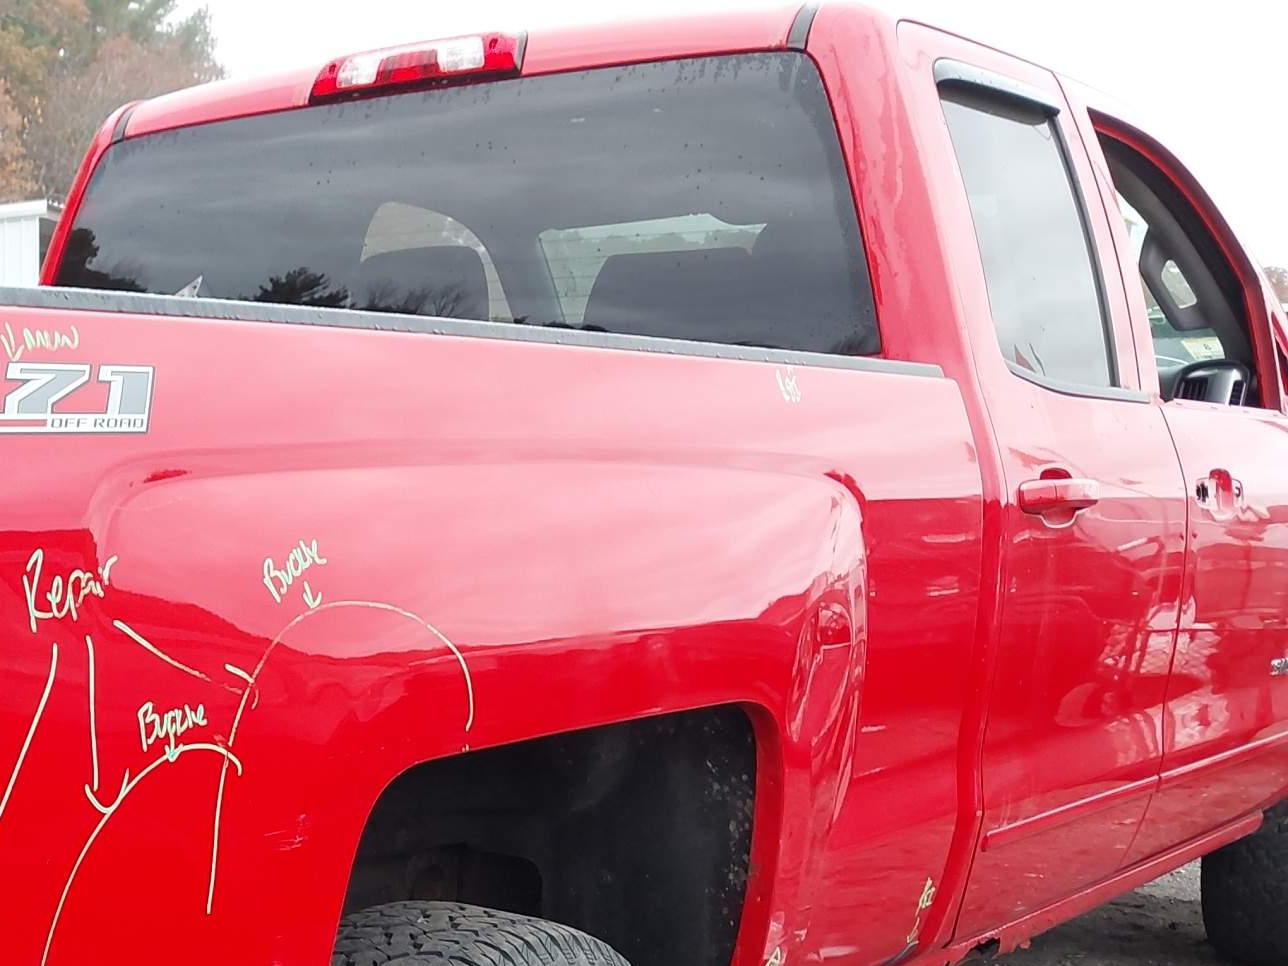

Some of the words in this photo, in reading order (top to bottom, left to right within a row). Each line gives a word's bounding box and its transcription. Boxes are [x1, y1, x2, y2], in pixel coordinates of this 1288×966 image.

[50, 417, 88, 429] OFF
[93, 417, 145, 429] ROAD
[23, 548, 118, 633] Repair
